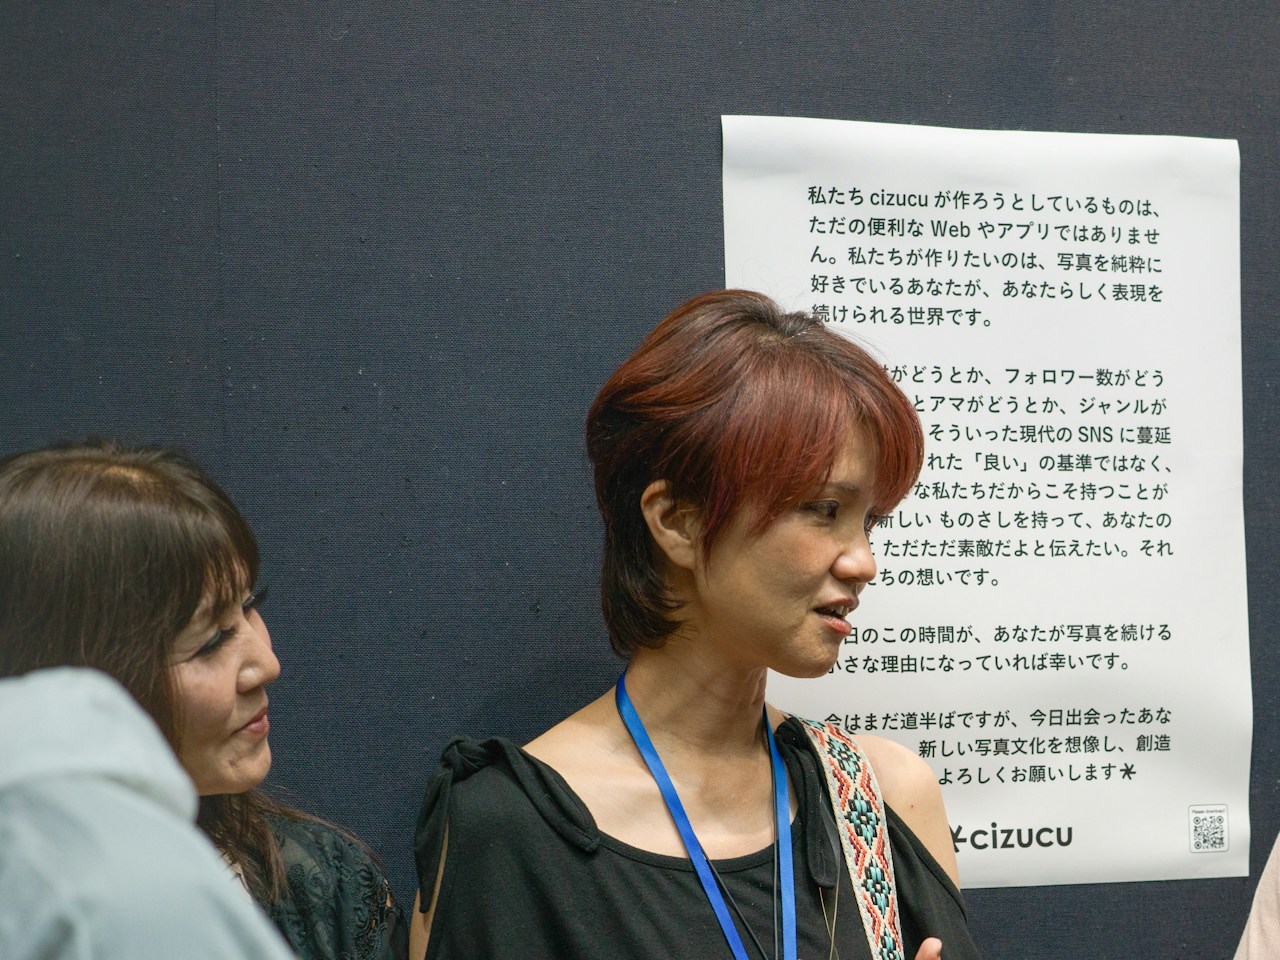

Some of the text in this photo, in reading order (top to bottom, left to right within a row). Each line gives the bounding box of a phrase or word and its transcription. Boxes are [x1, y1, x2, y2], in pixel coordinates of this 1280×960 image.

[807, 185, 1159, 218] 私たち cizucu が作ろうとしているものは、
[809, 215, 1161, 245] ただの便利な Web やアプリではありませ
[810, 245, 1163, 275] ん。私たちが作りたいのは、写真を純粋に
[810, 273, 1163, 303] 好きでいるあなたが、あなたらしく表現を
[812, 304, 991, 329] 続けられる世界です。
[884, 365, 1164, 390] がどうとか、フォロワー数がどう
[914, 394, 1167, 419] とアマがどうとか、ジャンルが
[928, 423, 1172, 445] そういった現代の SNS に蔓延
[927, 451, 1172, 473] れた「良い」の基準ではなく、
[914, 479, 1169, 501] な私たちだからこそ持つことが
[940, 510, 1172, 529] ものさしを持って、あなたの
[883, 538, 1174, 558] ただただ素敵だよと伝えたい。それ
[918, 733, 1172, 759] 新しい写真文化を想像し、創造
[969, 821, 1073, 851] cizucu
